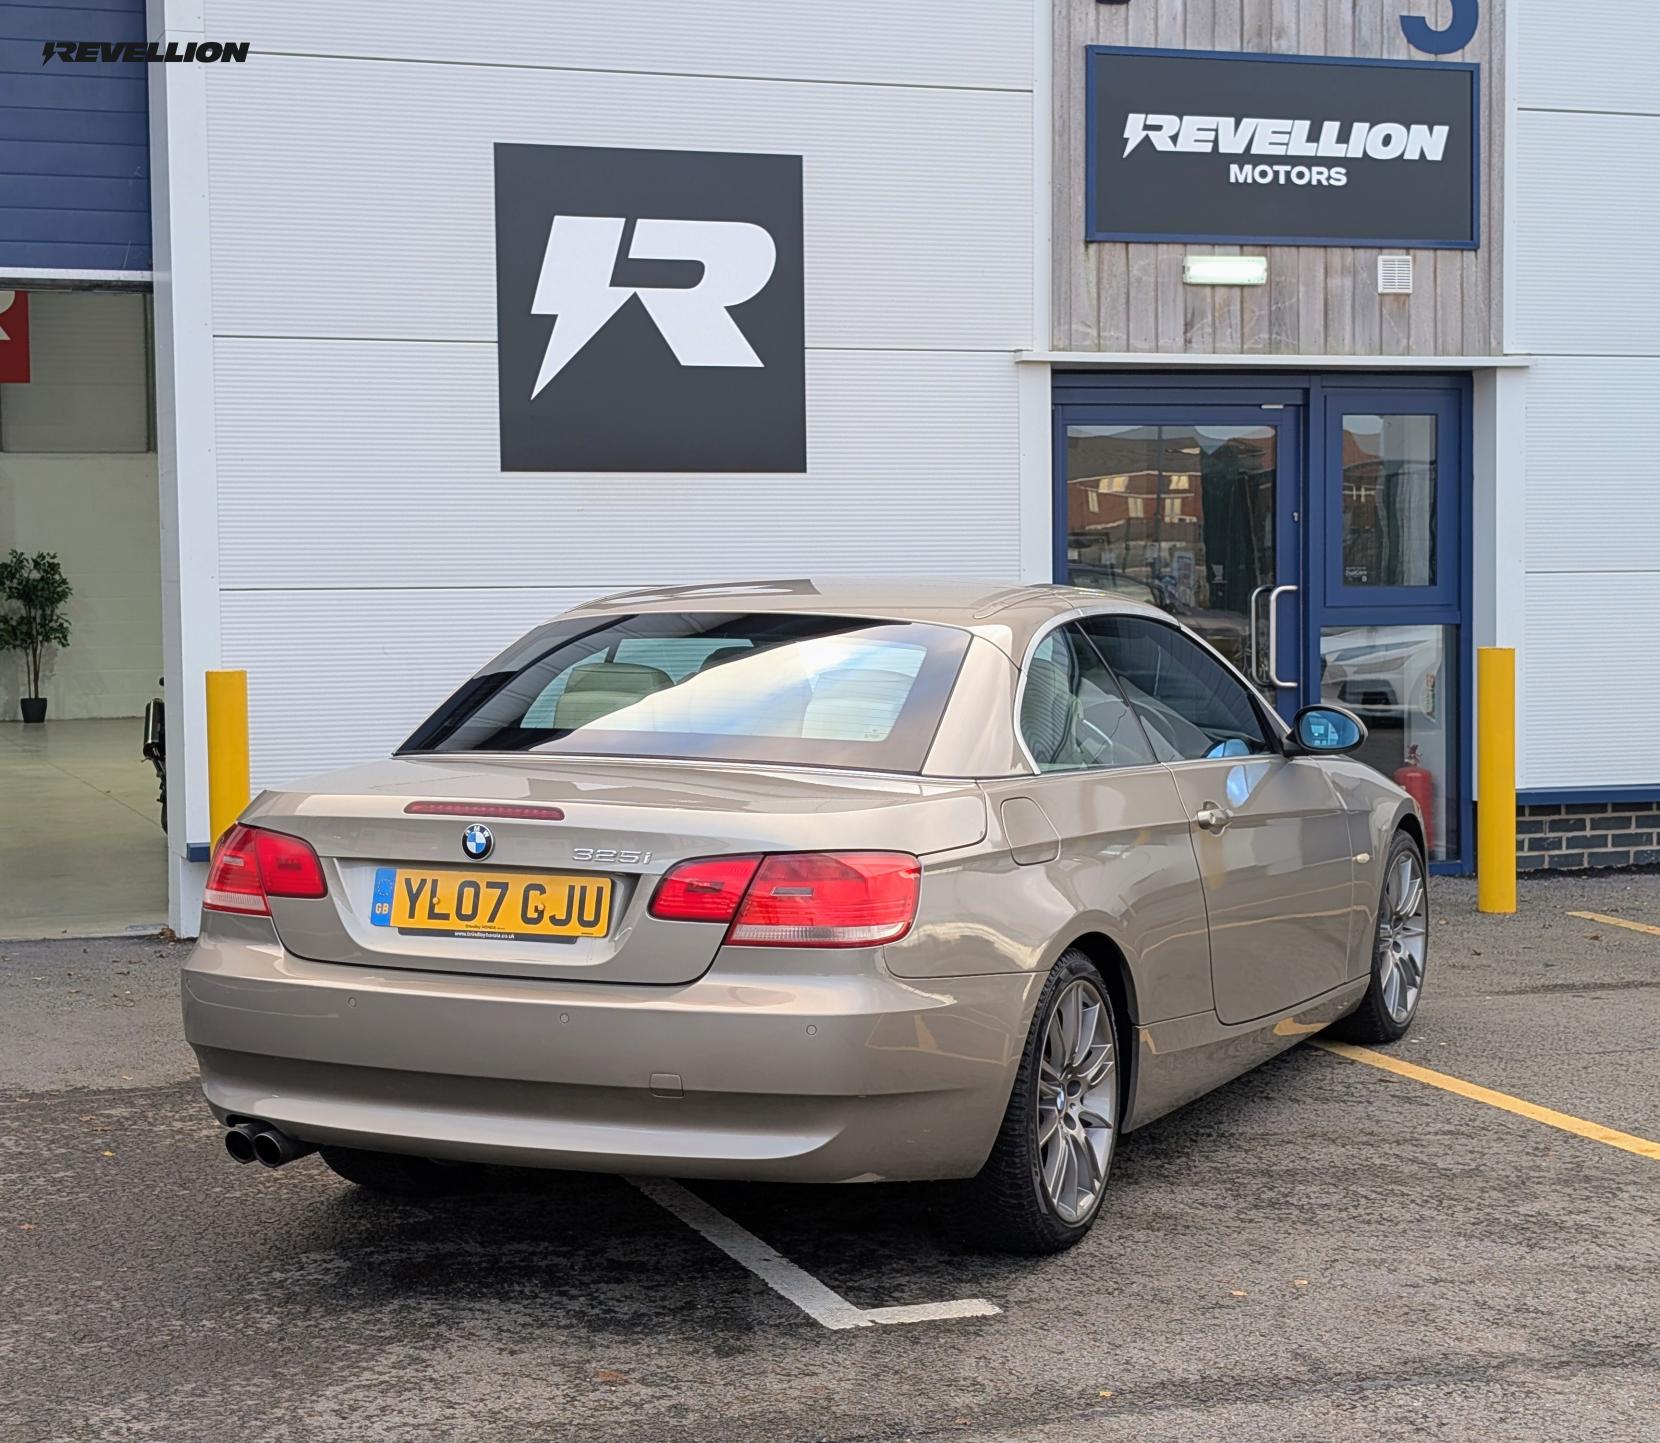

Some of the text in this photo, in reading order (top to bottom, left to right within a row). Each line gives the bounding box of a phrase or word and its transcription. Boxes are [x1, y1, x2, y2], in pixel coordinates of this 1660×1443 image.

[1122, 112, 1450, 162] REVELLION
[1228, 163, 1348, 187] MOTORS
[530, 214, 777, 401] R
[572, 847, 653, 865] 325i
[375, 902, 389, 914] GB
[404, 877, 604, 929] YL07 GJU
